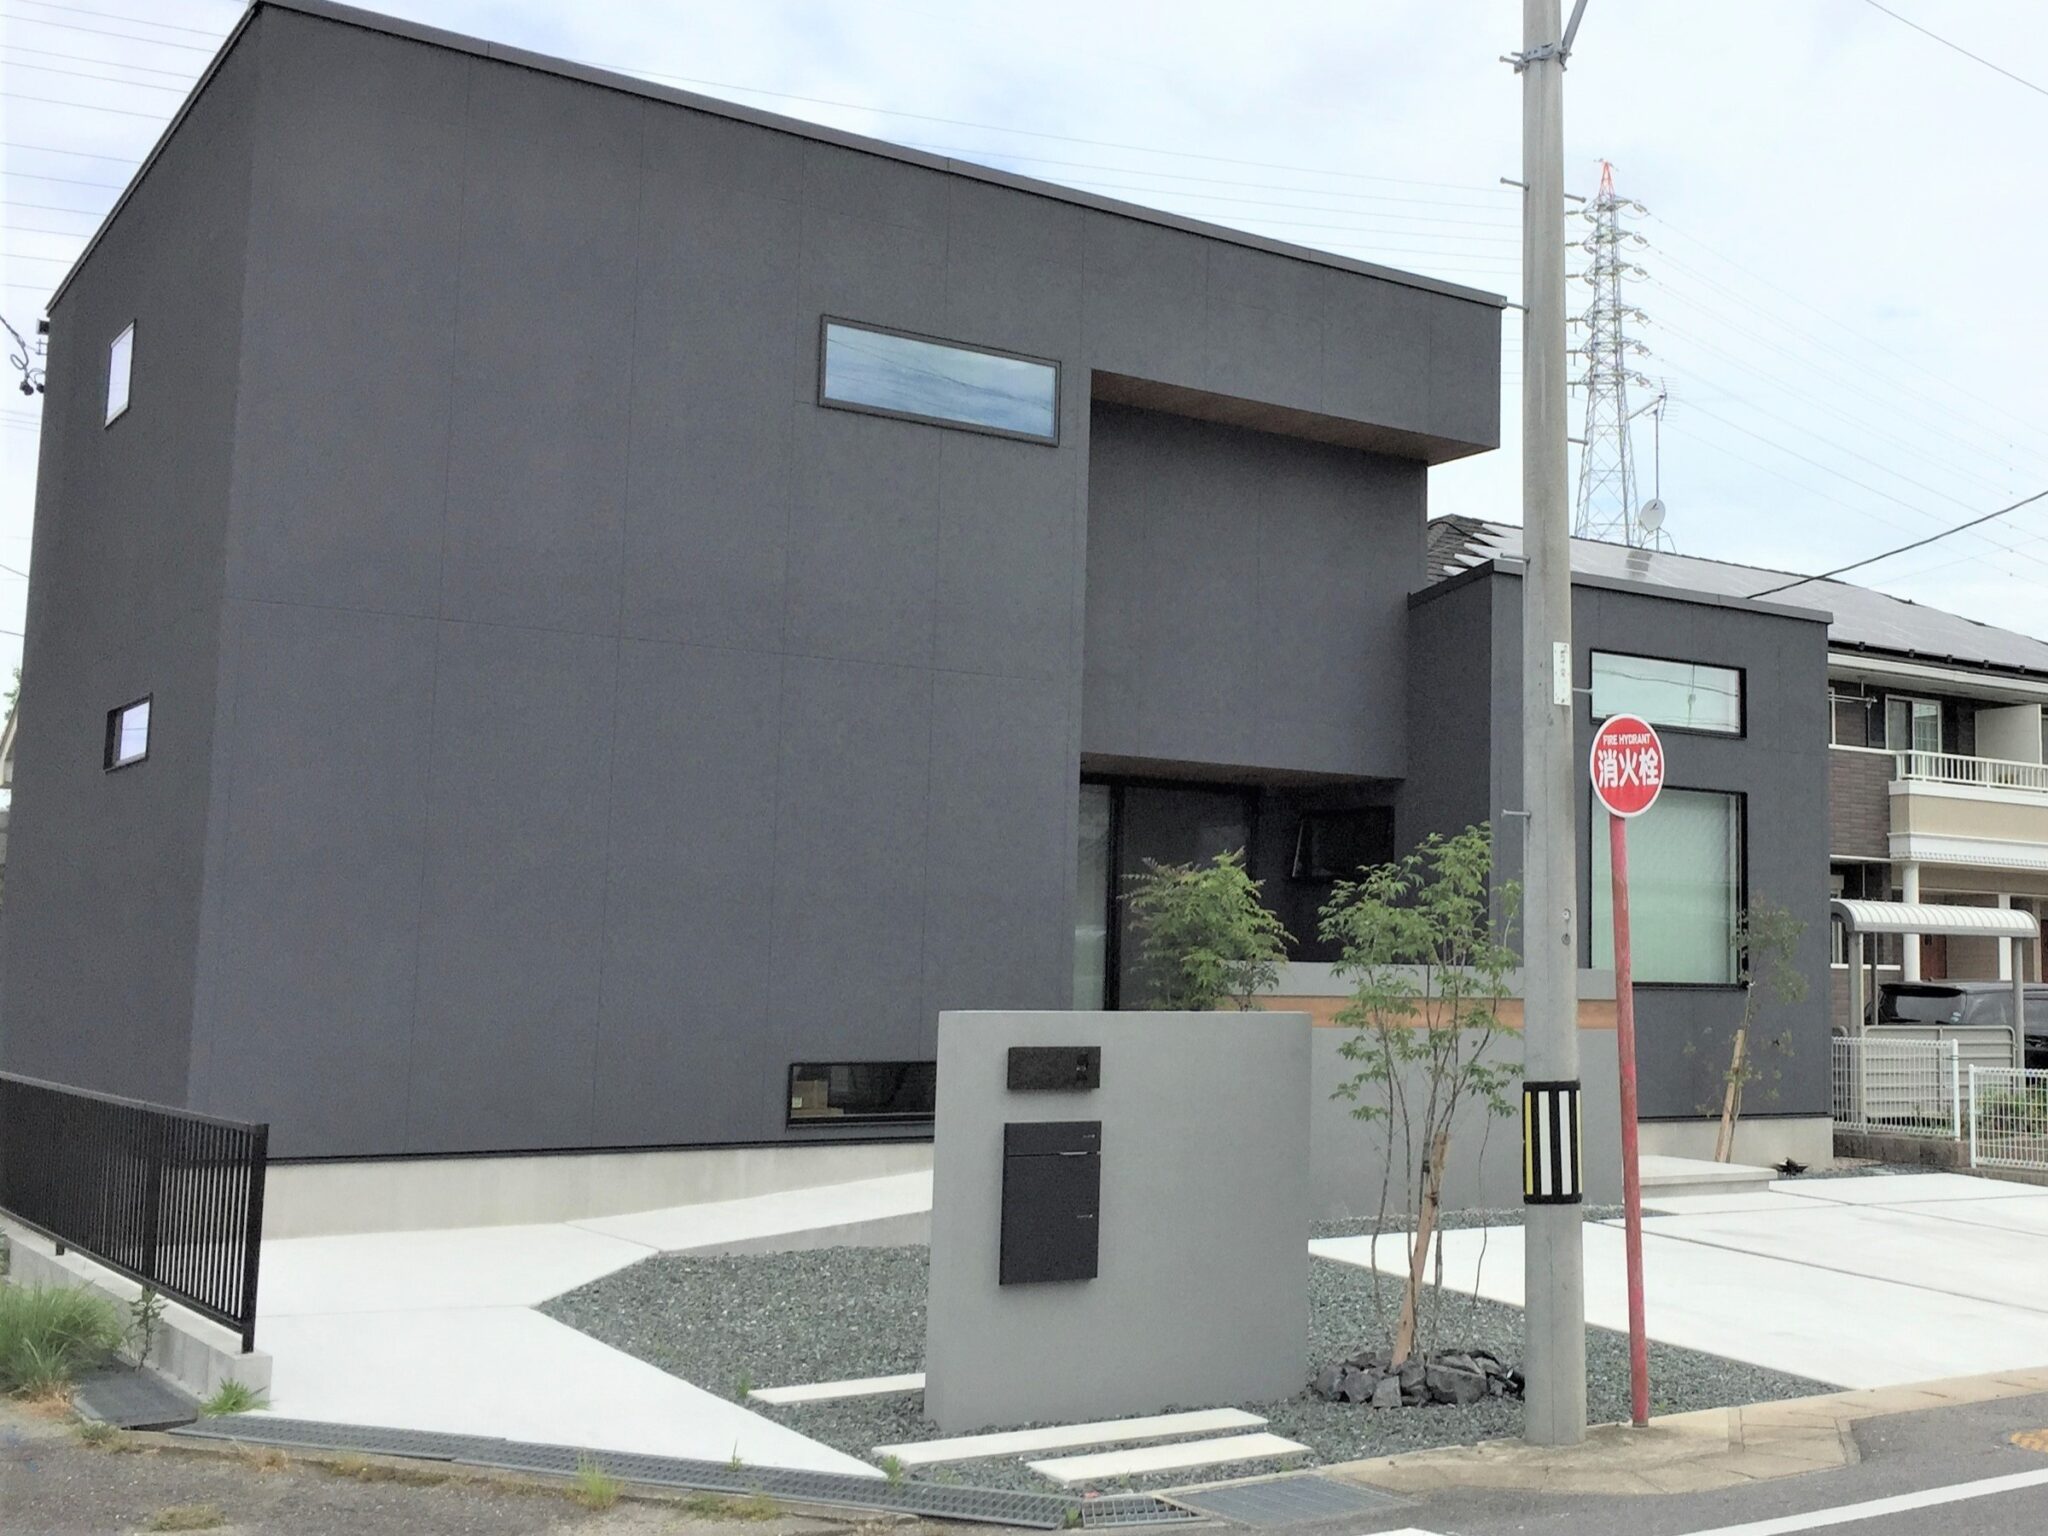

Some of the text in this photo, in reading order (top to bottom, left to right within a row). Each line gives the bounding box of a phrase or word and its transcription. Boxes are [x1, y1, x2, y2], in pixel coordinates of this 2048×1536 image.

[1602, 733, 1651, 746] FIRE HYDRANT
[1597, 747, 1660, 788] 消火栓
